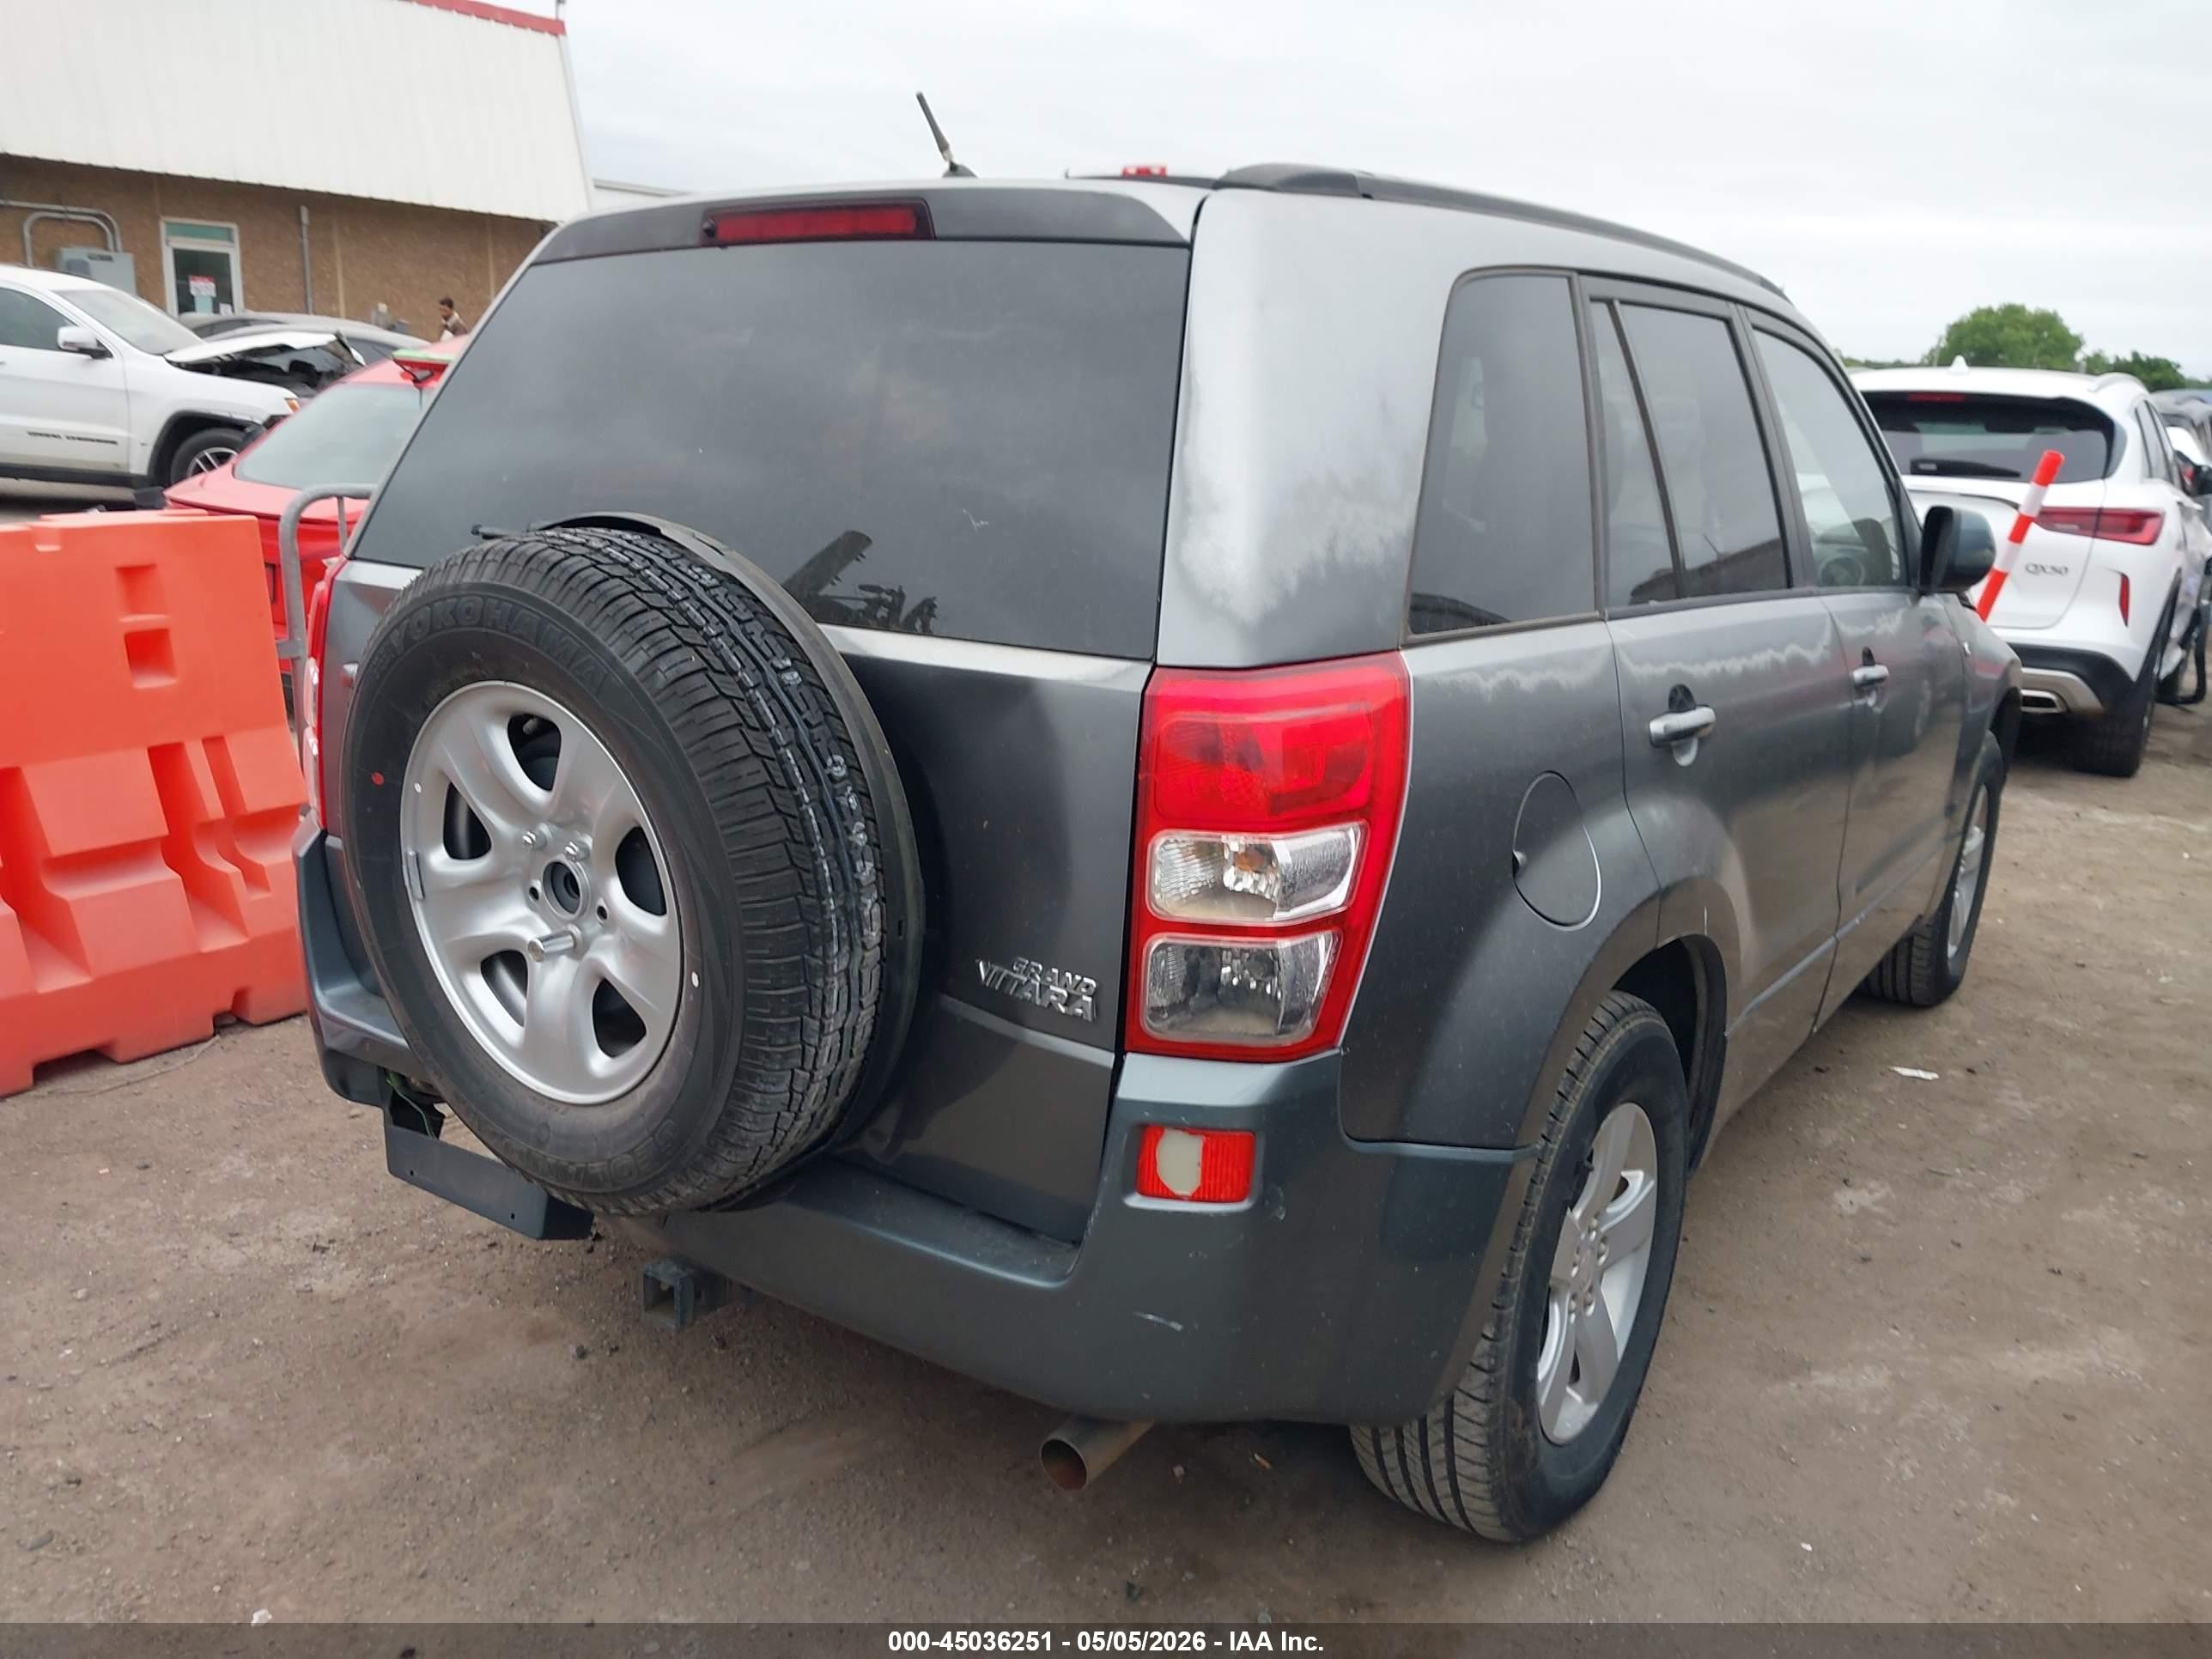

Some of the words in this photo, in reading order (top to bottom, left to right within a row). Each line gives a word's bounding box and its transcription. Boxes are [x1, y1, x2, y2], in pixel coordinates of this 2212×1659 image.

[2025, 562, 2069, 576] QX50
[389, 596, 607, 696] YOKOHAMA
[975, 957, 1097, 1022] VITARA
[1013, 957, 1097, 996] GRAND
